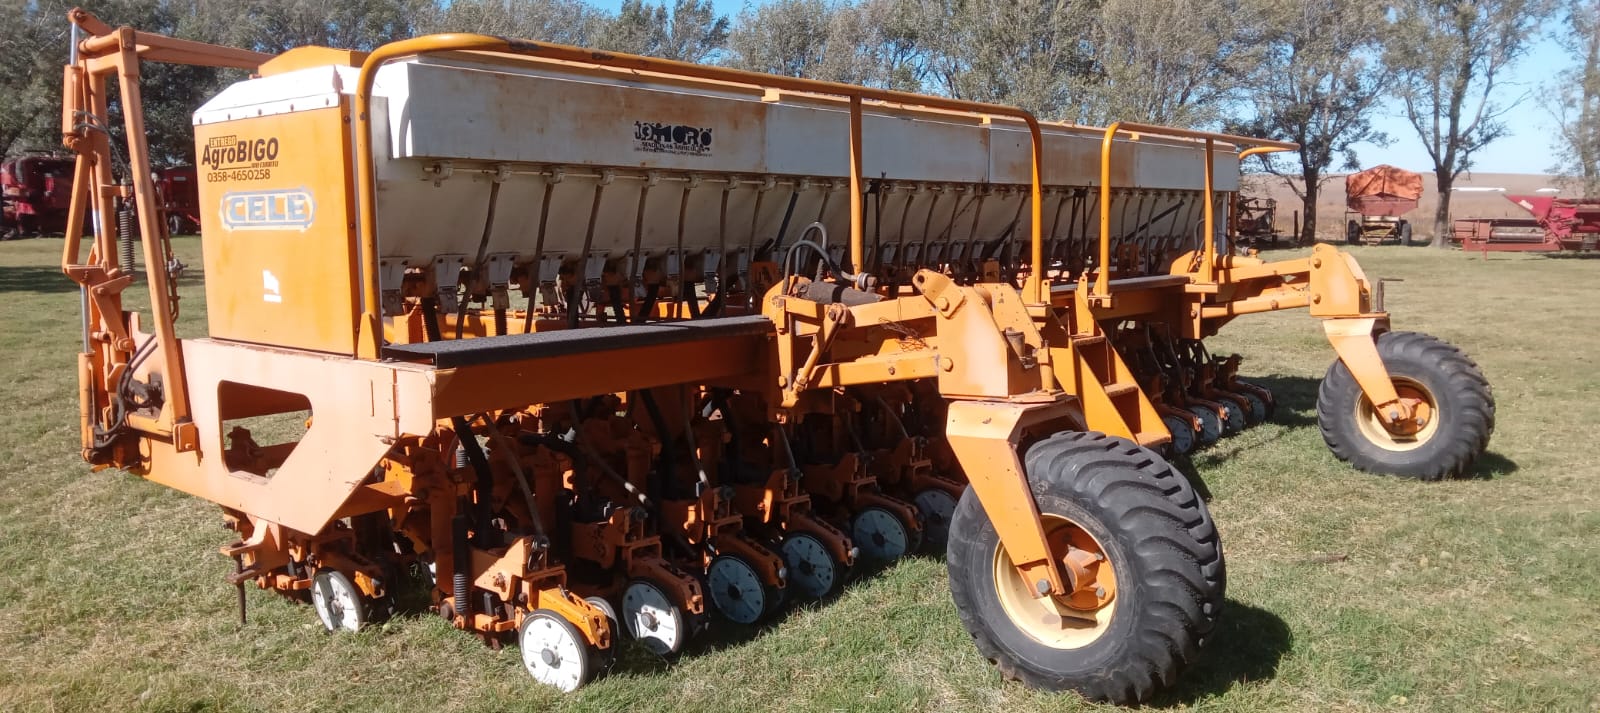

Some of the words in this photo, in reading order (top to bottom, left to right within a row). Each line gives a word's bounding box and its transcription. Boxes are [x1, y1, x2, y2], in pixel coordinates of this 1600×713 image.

[201, 137, 278, 170] AgroBIGO
[207, 169, 270, 182] 0358-4650258
[230, 195, 306, 221] CELE
